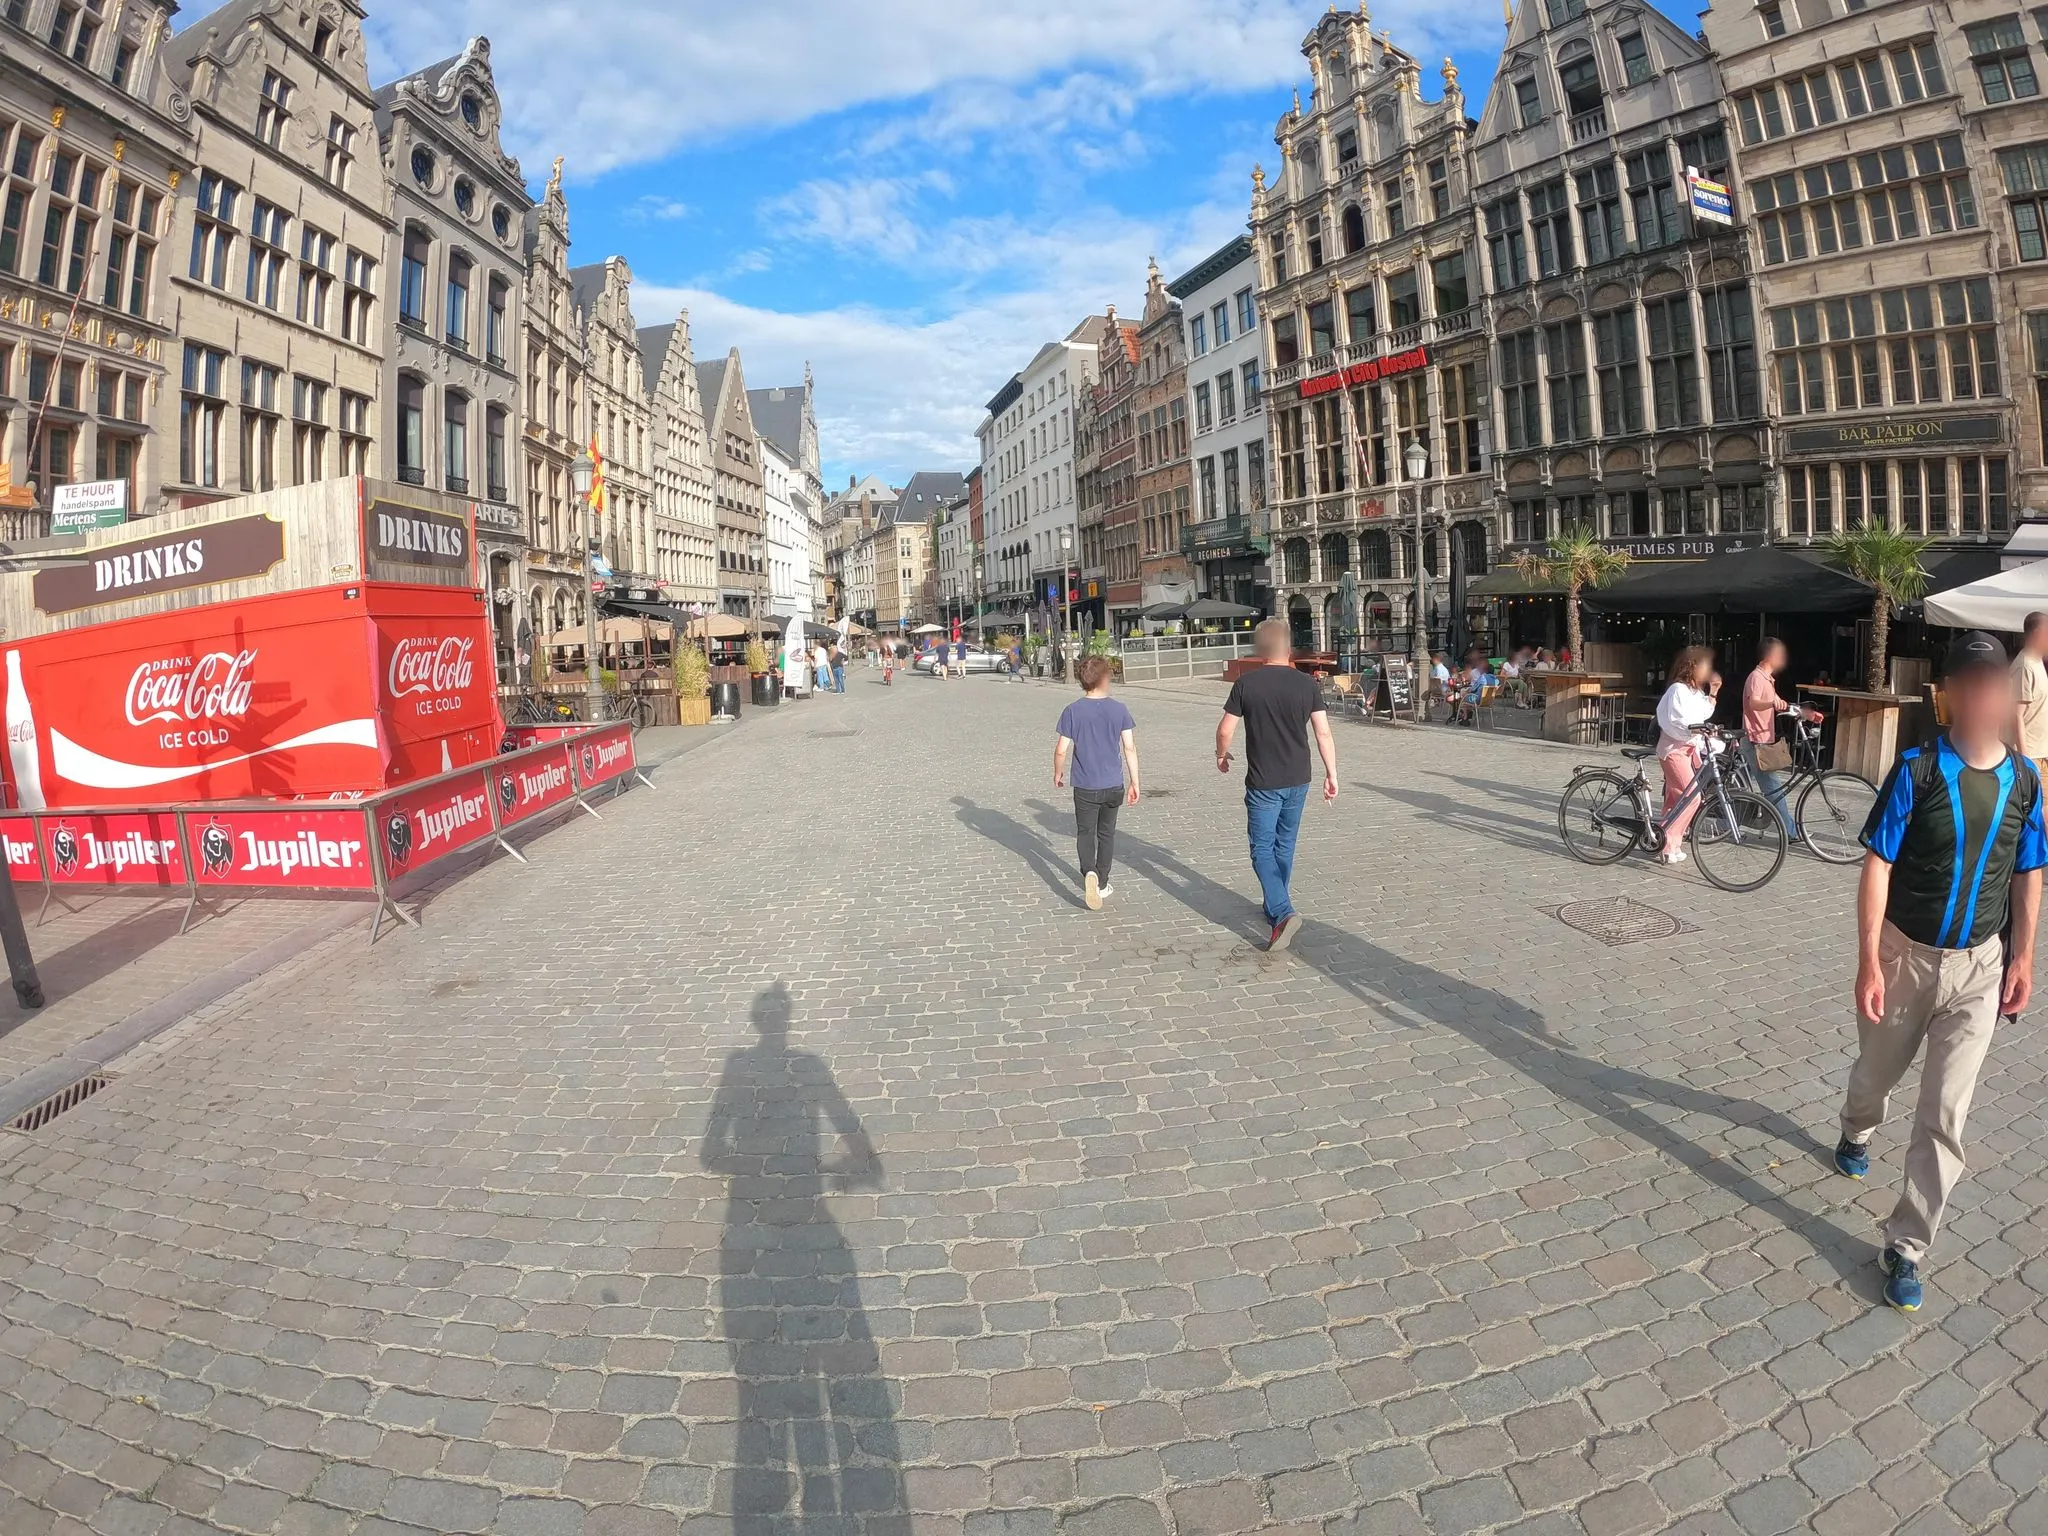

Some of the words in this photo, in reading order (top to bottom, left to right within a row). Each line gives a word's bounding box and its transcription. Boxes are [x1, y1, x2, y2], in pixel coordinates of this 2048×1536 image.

[1694, 189, 1730, 207] sorenco
[1301, 370, 1351, 397] Antwerp
[1351, 361, 1379, 383] City
[1378, 345, 1427, 376] Hostel
[1839, 427, 1871, 441] BAR
[1876, 421, 1943, 438] PATRON
[64, 488, 78, 498] TE
[82, 484, 115, 497] HUUR
[60, 498, 115, 510] handelspand
[54, 513, 97, 527] Mertens
[378, 513, 462, 557] DRINKS
[1626, 543, 1675, 555] TIMES
[1682, 542, 1714, 554] PUB
[94, 538, 203, 592] DRINKS
[410, 637, 438, 647] DRINK
[152, 656, 192, 671] DRINK
[389, 636, 474, 698] Coca-Cola
[125, 648, 258, 726] Coca-Cola
[416, 701, 433, 716] ICE
[435, 696, 462, 712] COLD
[160, 732, 183, 749] ICE
[187, 728, 229, 747] COLD
[596, 739, 627, 769] Jupiler
[518, 764, 567, 806] Jupiler
[415, 794, 485, 851] Jupiler
[81, 831, 176, 873] Jupiler
[239, 831, 361, 877] Jupiler
